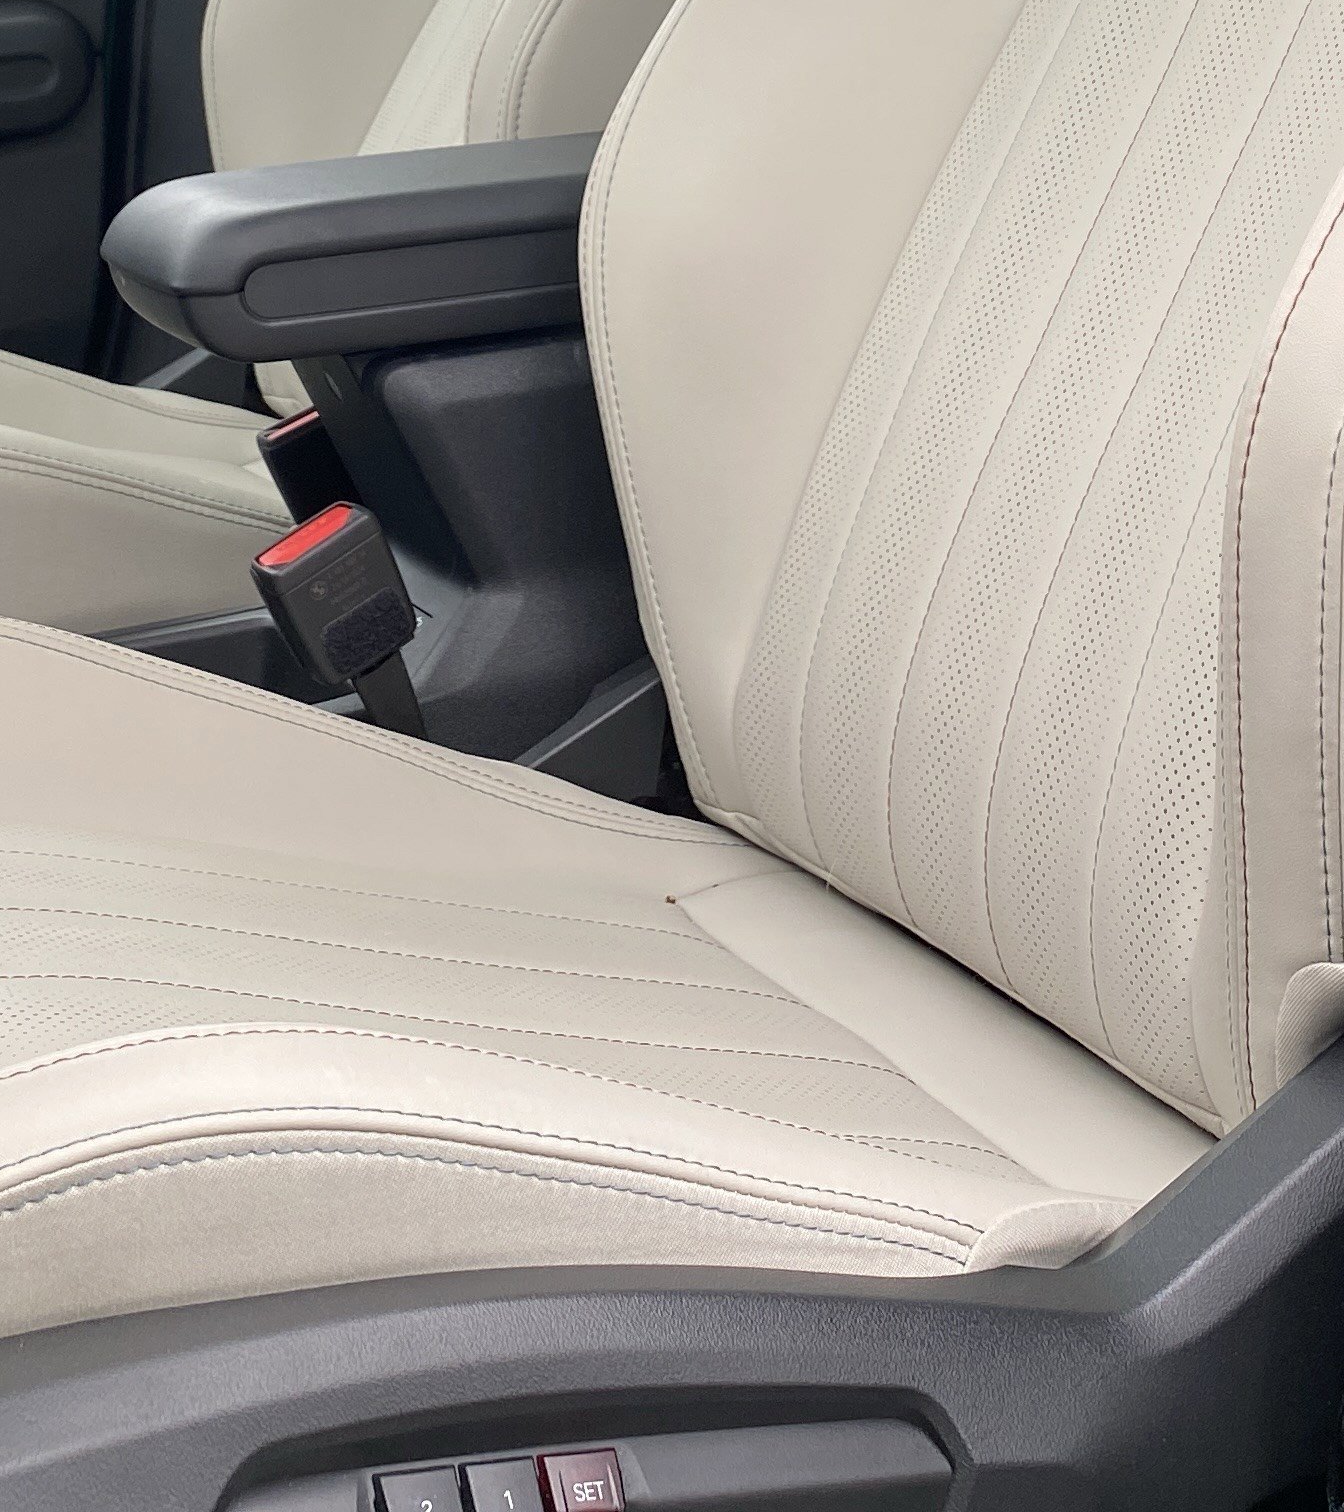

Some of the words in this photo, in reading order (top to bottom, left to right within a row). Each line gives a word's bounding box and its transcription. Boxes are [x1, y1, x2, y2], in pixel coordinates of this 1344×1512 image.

[503, 1489, 514, 1510] 1
[572, 1480, 604, 1502] SET
[420, 1499, 433, 1512] 2
